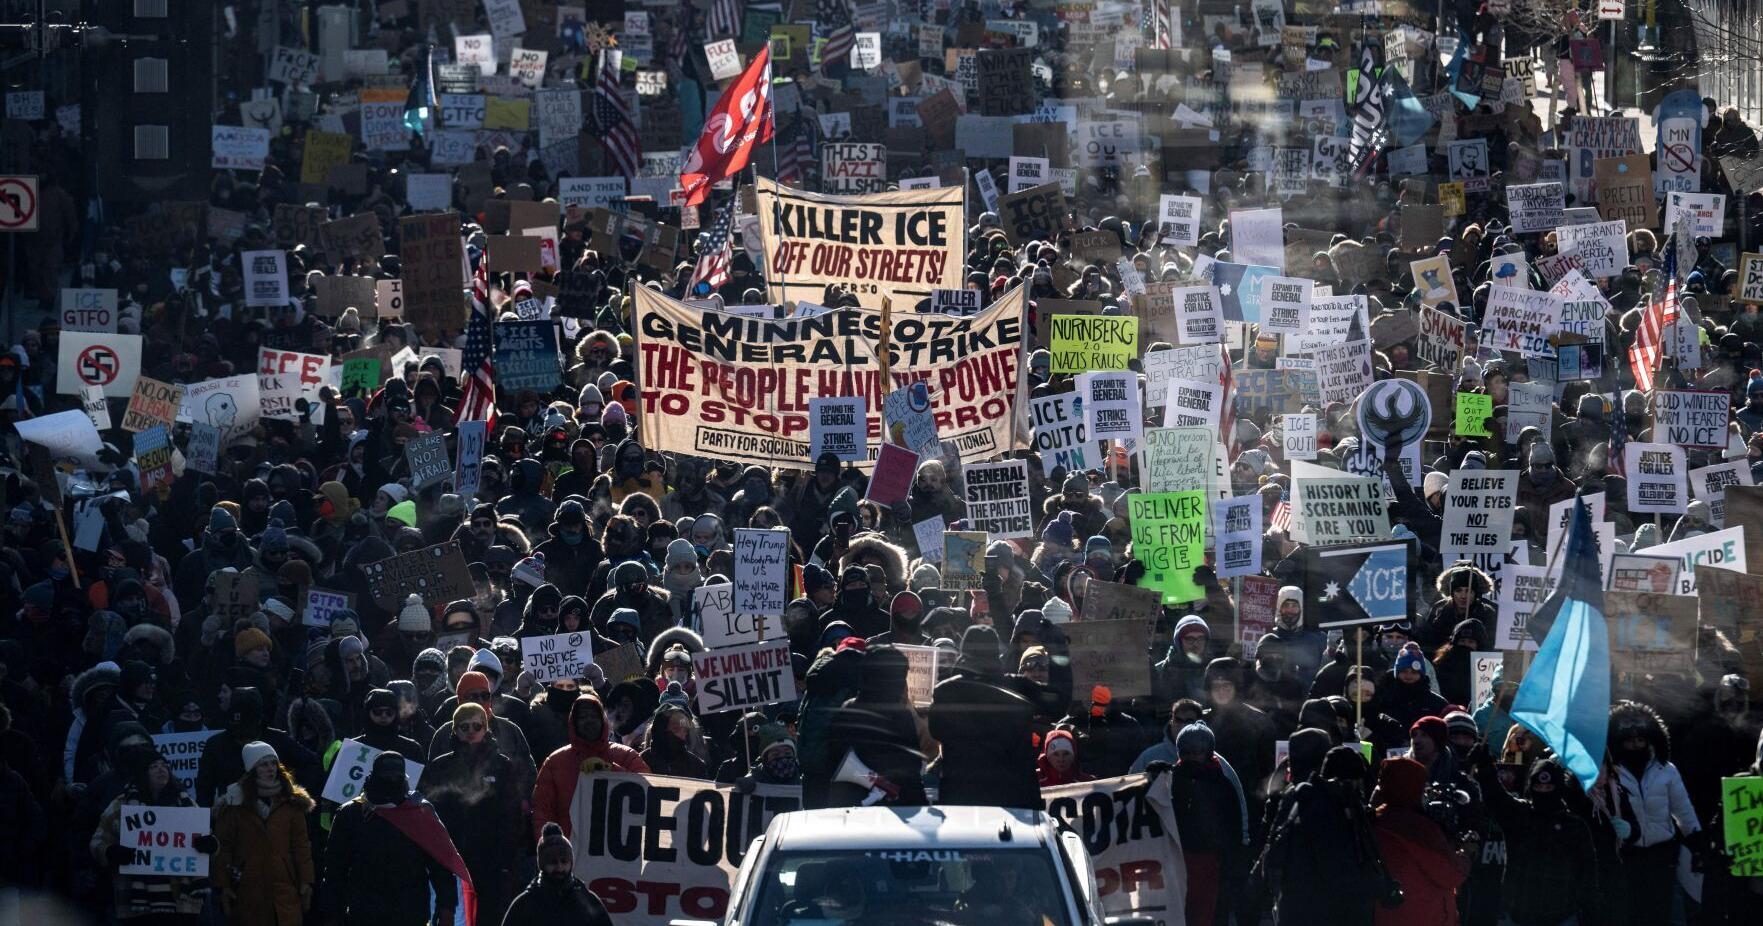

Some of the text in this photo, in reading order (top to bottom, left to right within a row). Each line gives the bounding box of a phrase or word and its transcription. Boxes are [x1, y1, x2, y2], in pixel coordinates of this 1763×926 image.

[522, 52, 539, 61] NO
[519, 70, 535, 79] NO
[1669, 128, 1689, 141] MN
[824, 146, 868, 162] THIS
[827, 162, 878, 178] NAZI
[1016, 169, 1041, 177] GENERAL
[595, 183, 623, 192] THEN
[1604, 184, 1645, 203] PRETTI
[1167, 208, 1192, 218] GENERAL
[1607, 206, 1647, 224] GOOD
[773, 202, 947, 247] KILLER ICE
[1558, 224, 1624, 241] IMMIGRANTS
[1577, 239, 1603, 248] MAKE
[773, 241, 946, 284] OFF OUR STREETS!
[1538, 255, 1585, 279] Justice
[1272, 283, 1304, 294] EXPAND THE
[74, 293, 101, 309] ICE
[938, 289, 975, 306] KILLER
[1184, 292, 1211, 303] JUSTICE
[1271, 292, 1301, 303] GENERAL
[1184, 302, 1213, 313] FOR ALEX
[1271, 307, 1299, 319] STRIKE!
[1493, 306, 1553, 324] HORCHATA
[64, 309, 110, 326] GTFO
[510, 326, 537, 338] ICE
[702, 311, 974, 343] MINNESOTA
[1052, 318, 1134, 344] NURNBERG
[1422, 310, 1464, 347] SHAME
[1497, 318, 1541, 335] WARM
[499, 337, 544, 350] AGENTS
[642, 313, 1021, 367] GENERAL STRIKE
[1437, 335, 1448, 344] ON
[1523, 335, 1551, 354] ICE
[1339, 344, 1367, 356] IS WHAT
[1052, 351, 1087, 370] NAZIS
[1294, 359, 1312, 368] ICE
[1321, 362, 1356, 374] IT SOUNDS
[641, 343, 696, 391] THE
[701, 360, 811, 413] PEOPLE
[940, 348, 1021, 409] POWE
[1091, 379, 1127, 391] EXPAND THE
[1327, 372, 1363, 387] LIKE WHEN
[136, 381, 152, 396] NO
[1092, 389, 1127, 402] GENERAL
[1178, 387, 1212, 402] EXPAND THE
[1326, 389, 1348, 402] DOVES
[1177, 397, 1210, 412] GENERAL
[1462, 395, 1485, 405] ICE
[1655, 394, 1728, 410] COLD WINTERS
[641, 391, 809, 436] TO STOP
[820, 404, 855, 415] EXPAND THE
[1034, 398, 1064, 426] ICE
[1097, 410, 1127, 422] STRIKE!
[1464, 407, 1482, 415] OUT
[820, 414, 855, 426] GENERAL
[1177, 414, 1207, 426] STRIKE!
[1288, 417, 1311, 431] ICE
[1655, 412, 1727, 426] WARM HEARTS
[410, 435, 441, 452] WE ARE
[702, 431, 736, 451] PARTY
[737, 436, 758, 452] FOR
[823, 433, 854, 445] STRIKE!
[1038, 430, 1069, 452] OUT
[1668, 427, 1718, 444] NO ICE
[139, 448, 170, 471] ICE OUT
[415, 448, 439, 464] NOT
[1055, 450, 1086, 470] MN
[1639, 451, 1672, 464] JUSTICE
[416, 460, 449, 482] AFRAID
[966, 465, 1026, 484] GENERAL
[1638, 463, 1674, 475] FOR ALEX
[1705, 469, 1737, 484] JUSTICE
[968, 481, 1027, 502] STRIKE:
[1306, 483, 1380, 499] HISTORY IS
[1461, 478, 1505, 490] BELIEVE
[1638, 483, 1657, 491] JEFFREY
[1705, 481, 1718, 494] FOR
[1451, 496, 1511, 508] YOUR EYES
[1638, 490, 1656, 499] KILLED
[969, 498, 1029, 519] THE PATH TO
[1134, 496, 1201, 520] DELIVER
[1225, 503, 1250, 519] JUSTICE
[1305, 502, 1382, 517] SCREAMING
[974, 516, 1030, 533] JUSTICE
[1225, 517, 1252, 534] FOR ALEX
[1315, 519, 1375, 535] ARE YOU
[1467, 514, 1487, 526] NOT
[1136, 522, 1201, 545] US FROM
[1450, 533, 1497, 546] THE LIES
[736, 534, 786, 558] Hey Trump
[1143, 546, 1191, 571] ICE
[752, 565, 767, 576] US
[1244, 580, 1276, 595] SALT THE
[1364, 567, 1406, 601] ICE
[310, 592, 346, 609] GTFO
[539, 639, 555, 651] NO
[527, 649, 578, 667] JUSTICE
[695, 647, 790, 679] WE WILL NOT BE
[548, 662, 585, 678] PEACE
[704, 670, 782, 710] SILENT
[125, 811, 156, 831] NO
[589, 778, 680, 862] ICE
[154, 855, 197, 873] ICE
[589, 877, 730, 919] STO
